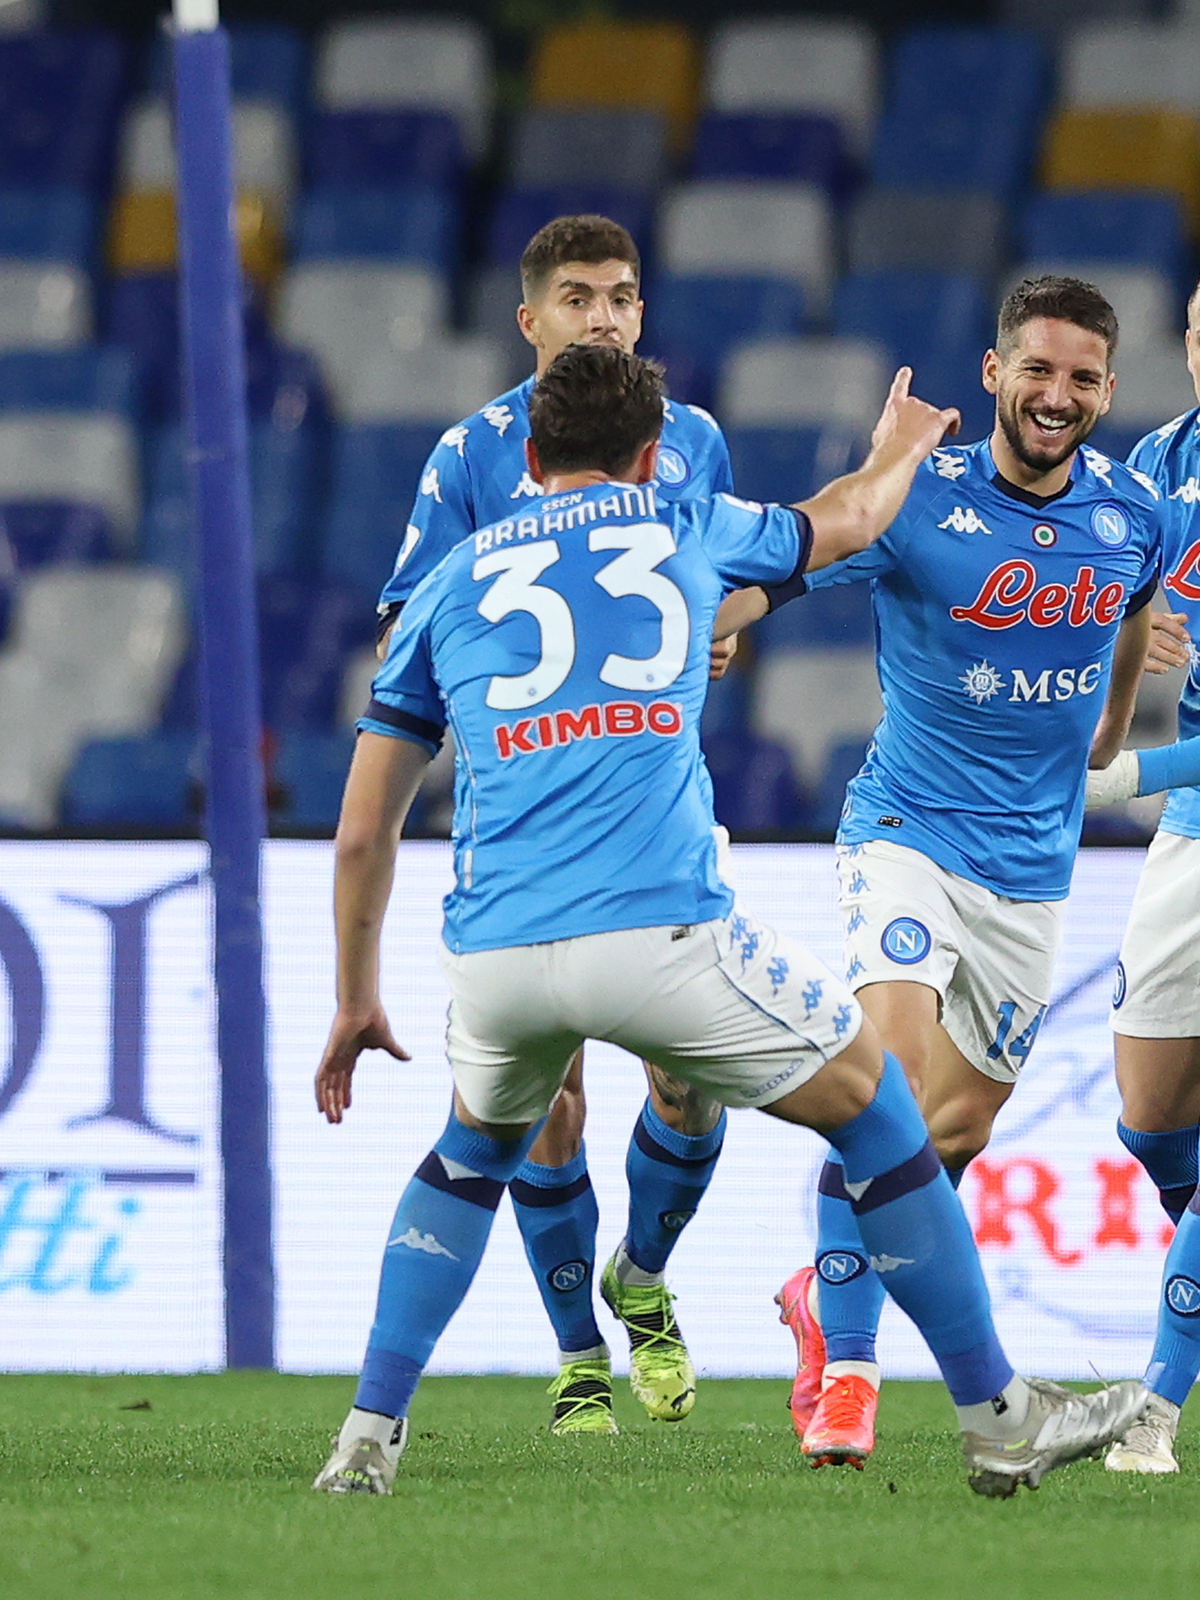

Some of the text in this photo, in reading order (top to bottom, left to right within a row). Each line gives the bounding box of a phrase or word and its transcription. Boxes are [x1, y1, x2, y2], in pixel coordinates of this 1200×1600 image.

[475, 486, 657, 556] RRAHMANI
[471, 522, 691, 711] 33
[950, 558, 1125, 631] Lete
[1008, 662, 1102, 703] MSC
[494, 701, 683, 761] KIMBO
